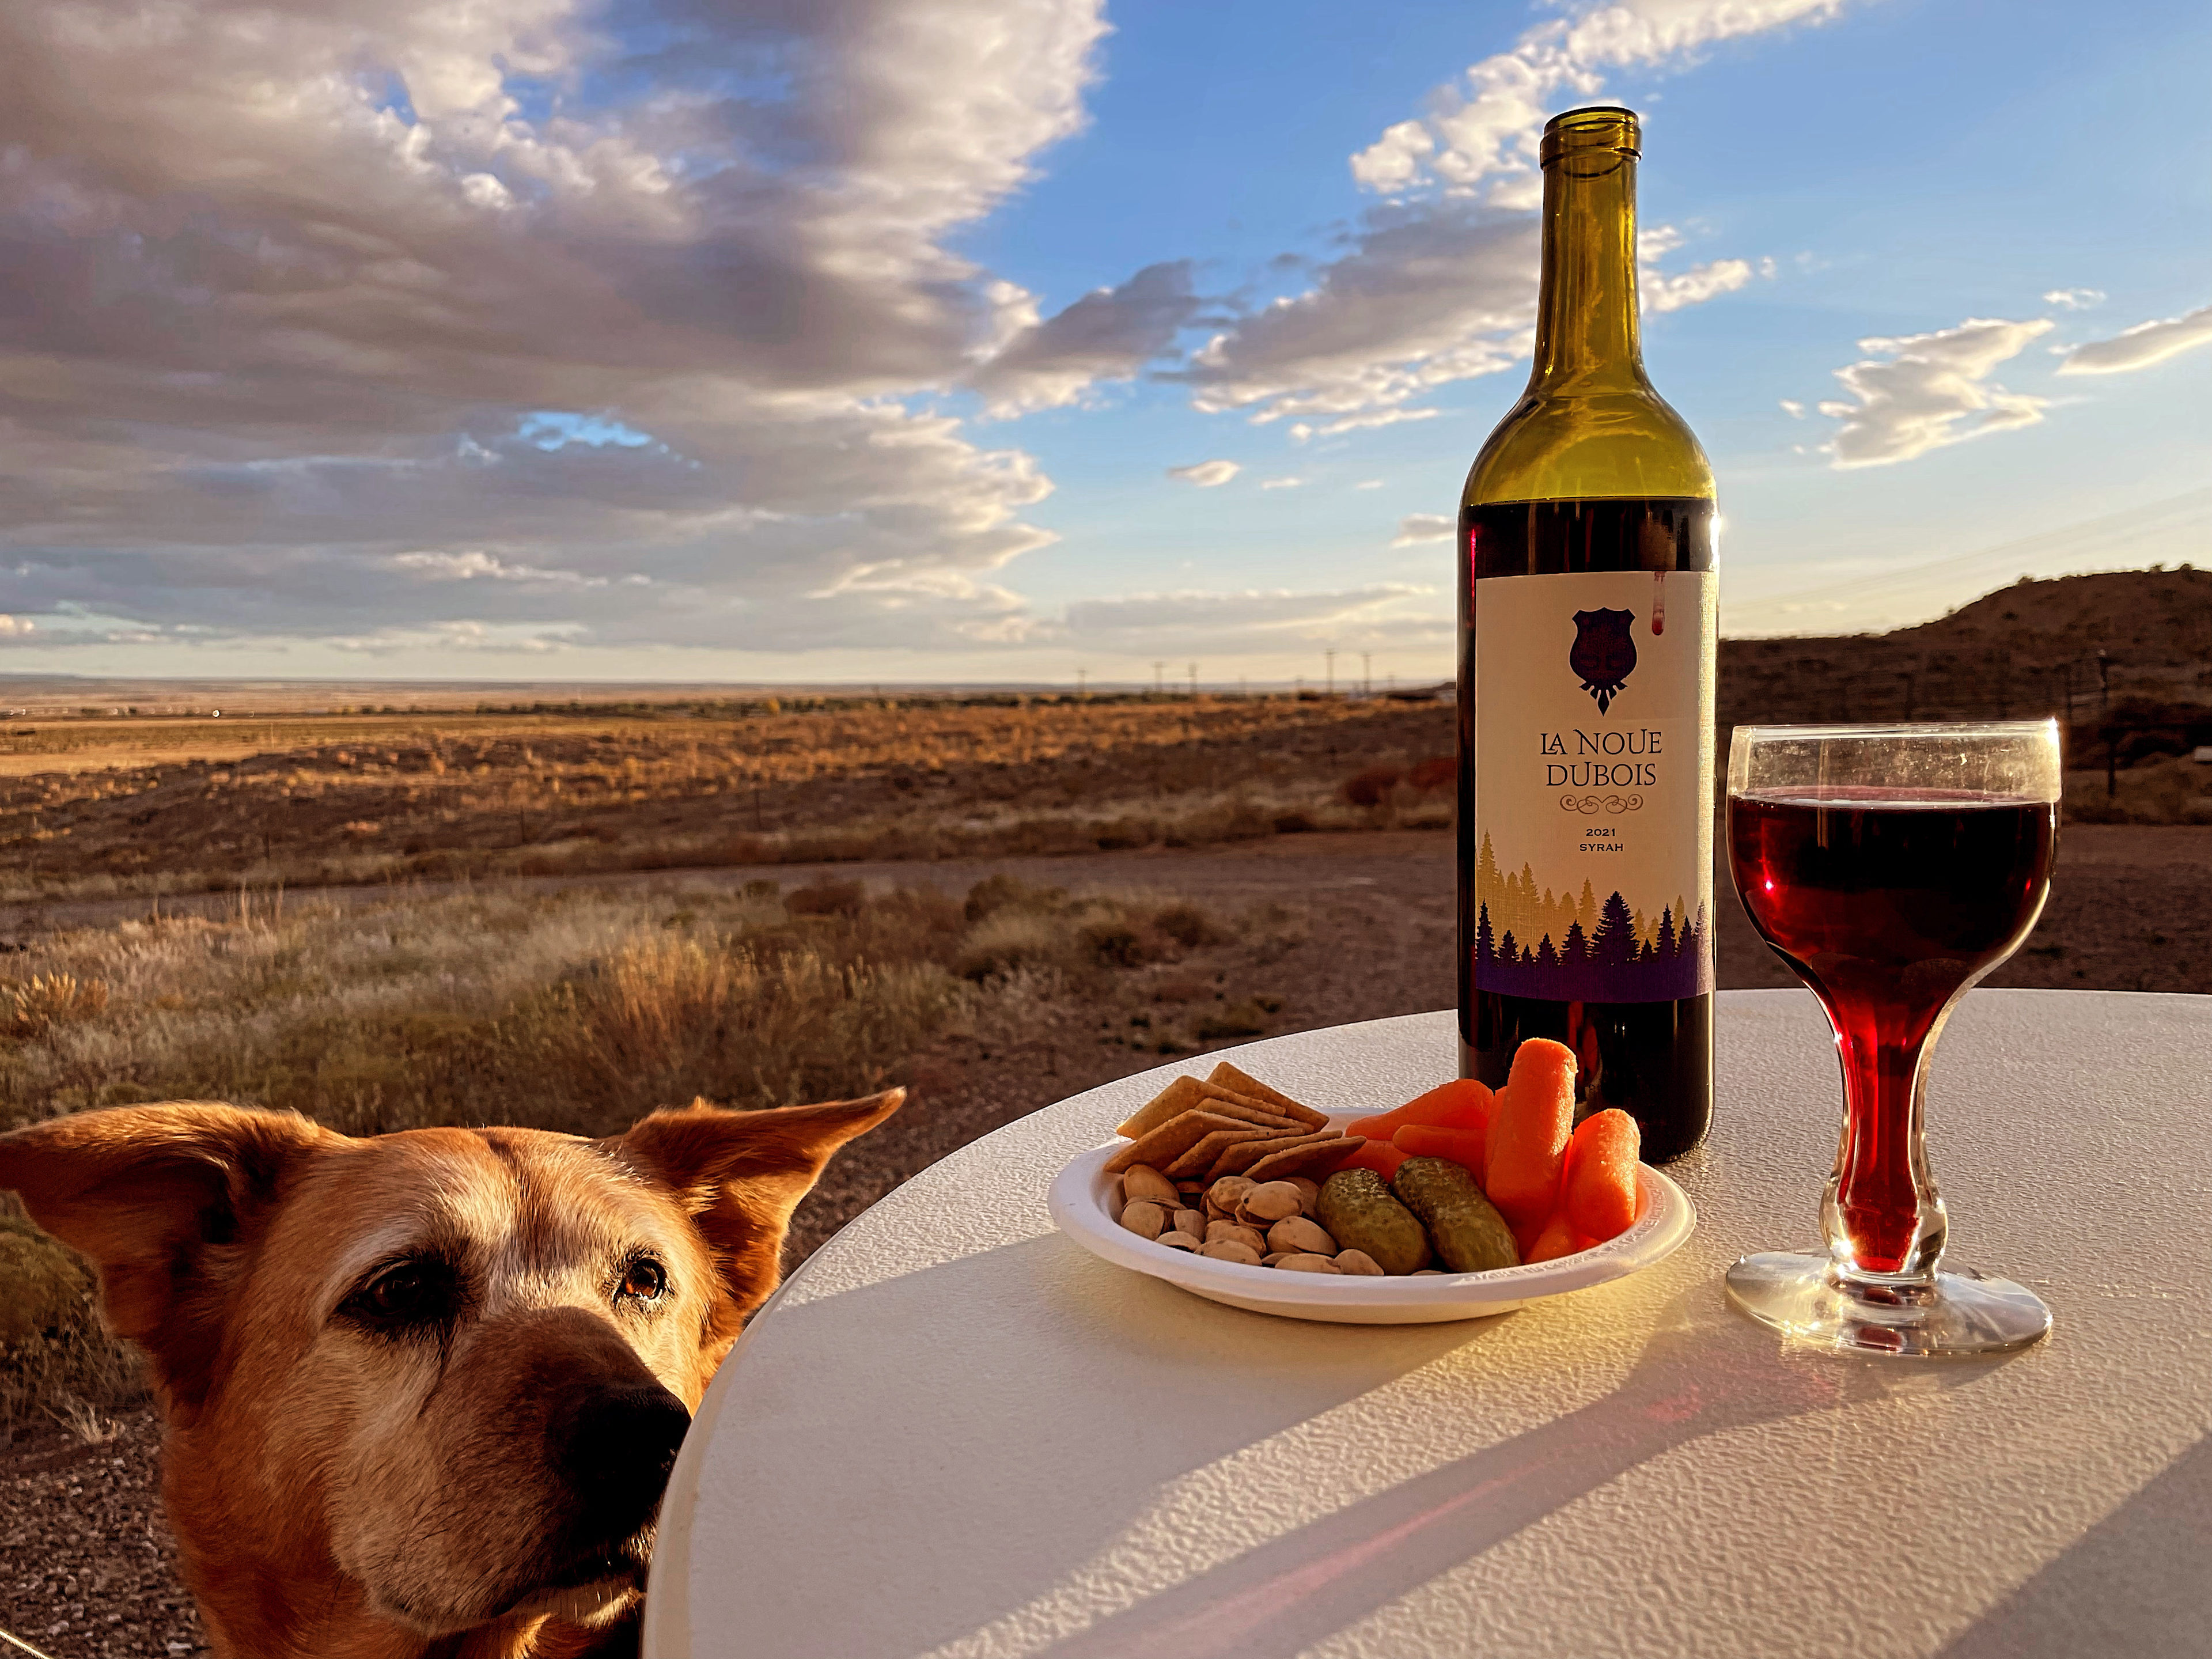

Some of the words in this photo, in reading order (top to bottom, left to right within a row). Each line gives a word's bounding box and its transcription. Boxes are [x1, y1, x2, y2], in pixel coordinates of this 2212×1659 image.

[1540, 733, 1568, 755] LA
[1573, 729, 1662, 755] NOUE
[1546, 762, 1656, 787] DUBOIS
[1586, 828, 1616, 836] 2021
[1580, 843, 1624, 852] SYRAH
